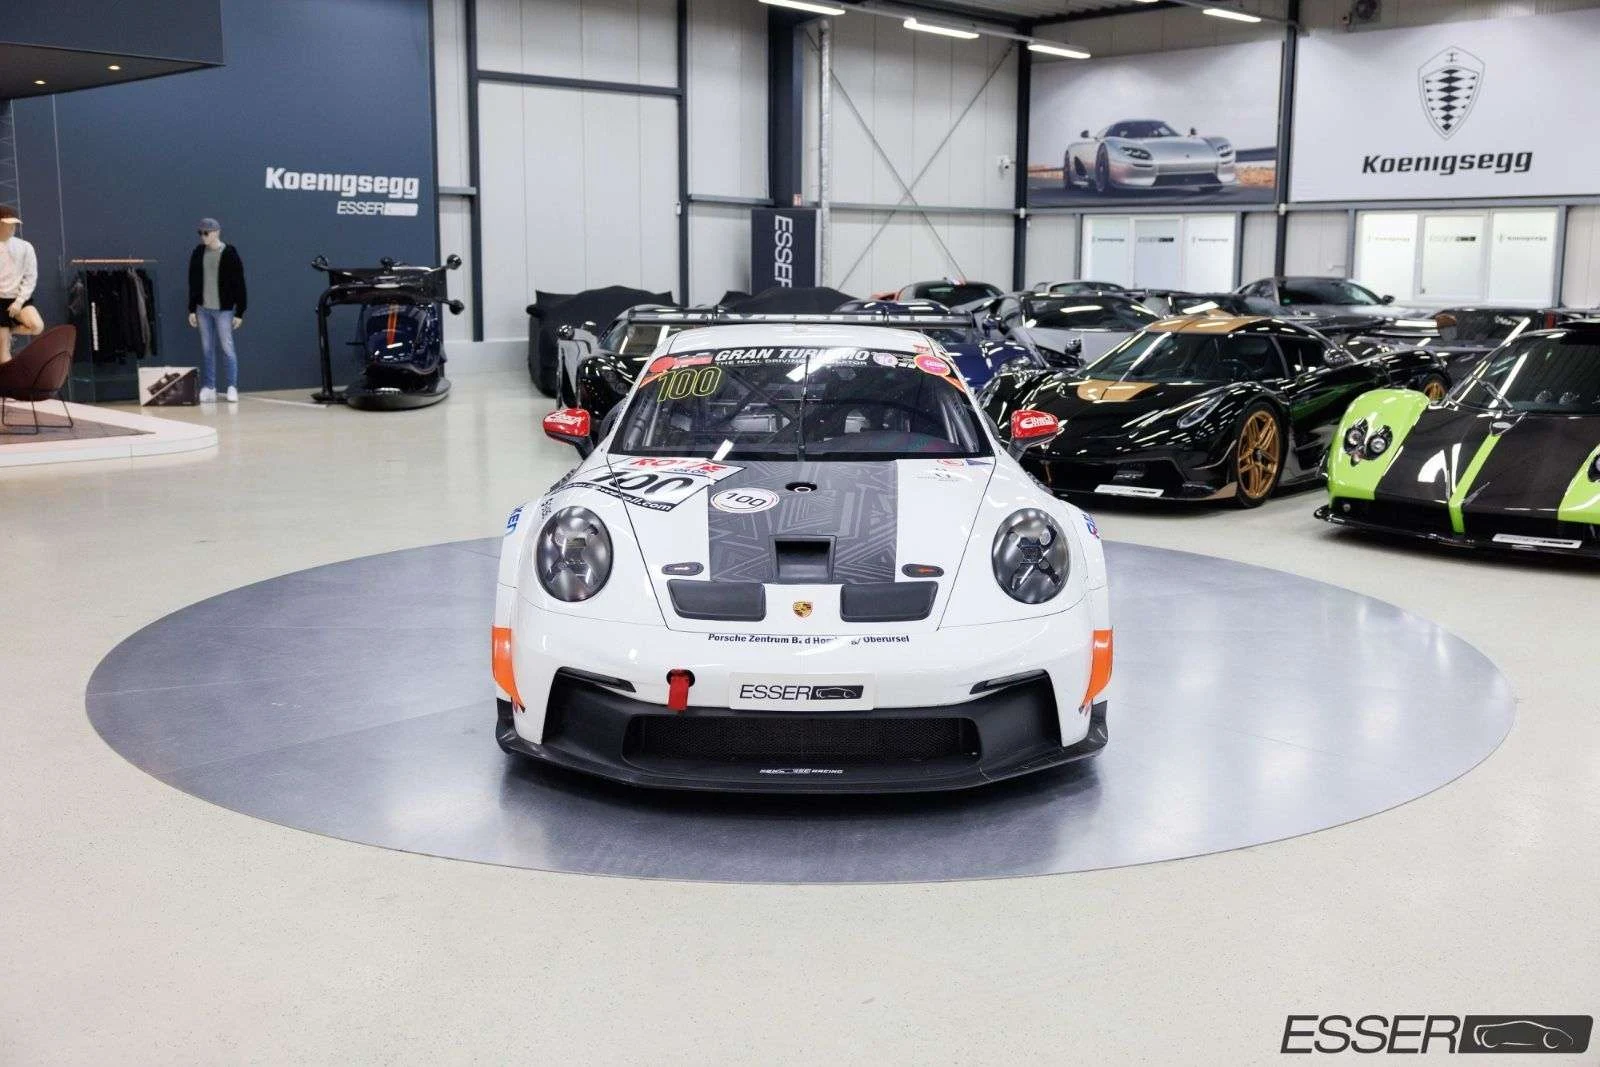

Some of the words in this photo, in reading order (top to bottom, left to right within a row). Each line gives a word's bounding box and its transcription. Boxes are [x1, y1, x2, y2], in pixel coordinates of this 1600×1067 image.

[1362, 151, 1533, 176] Koenigsegg
[265, 167, 419, 199] Koenigsegg
[336, 201, 384, 215] ESSER
[715, 348, 775, 361] GRAN
[657, 366, 721, 402] 100
[726, 493, 767, 507] 100
[708, 633, 747, 642] Porsche
[749, 635, 789, 644] Zentrum
[863, 635, 910, 644] Oberursel
[739, 684, 811, 701] ESSER
